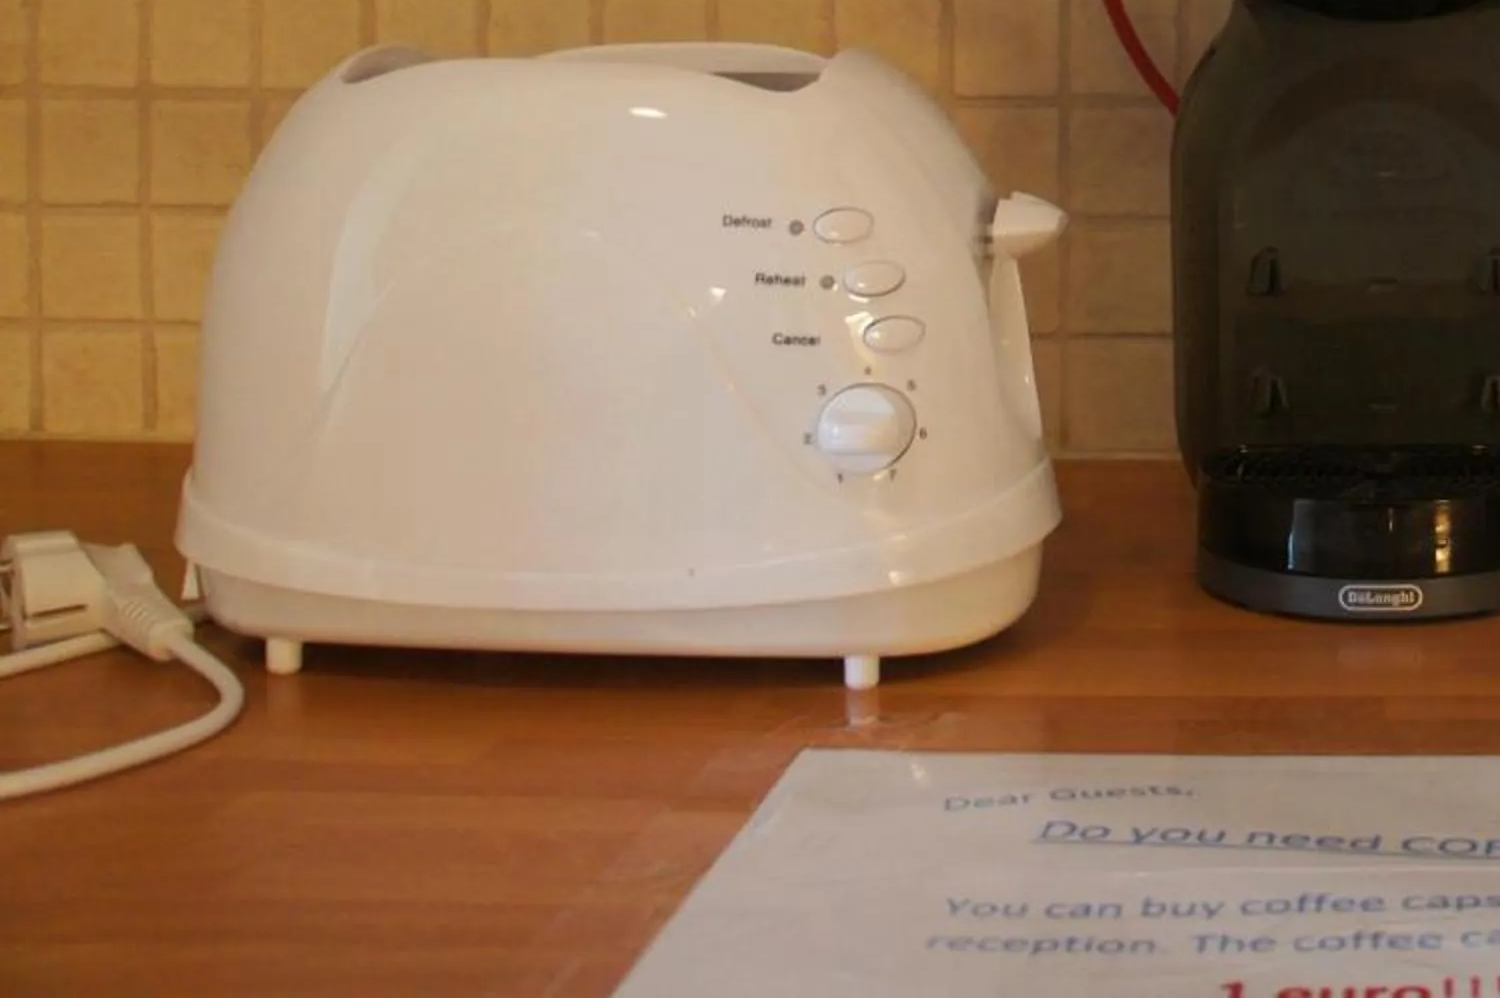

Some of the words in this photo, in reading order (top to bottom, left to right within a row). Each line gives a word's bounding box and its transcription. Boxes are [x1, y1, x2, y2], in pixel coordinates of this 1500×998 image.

[722, 214, 773, 229] Defrost
[754, 272, 806, 287] Reheat
[944, 793, 1032, 812] Dear
[1040, 820, 1112, 841] Do
[1130, 825, 1227, 845] you
[1246, 831, 1382, 851] need
[946, 898, 1030, 920] You
[1044, 903, 1123, 919] can
[1141, 897, 1225, 922] buy
[1240, 892, 1385, 916] coffee
[1191, 934, 1277, 954] The
[1293, 929, 1443, 951] coffee
